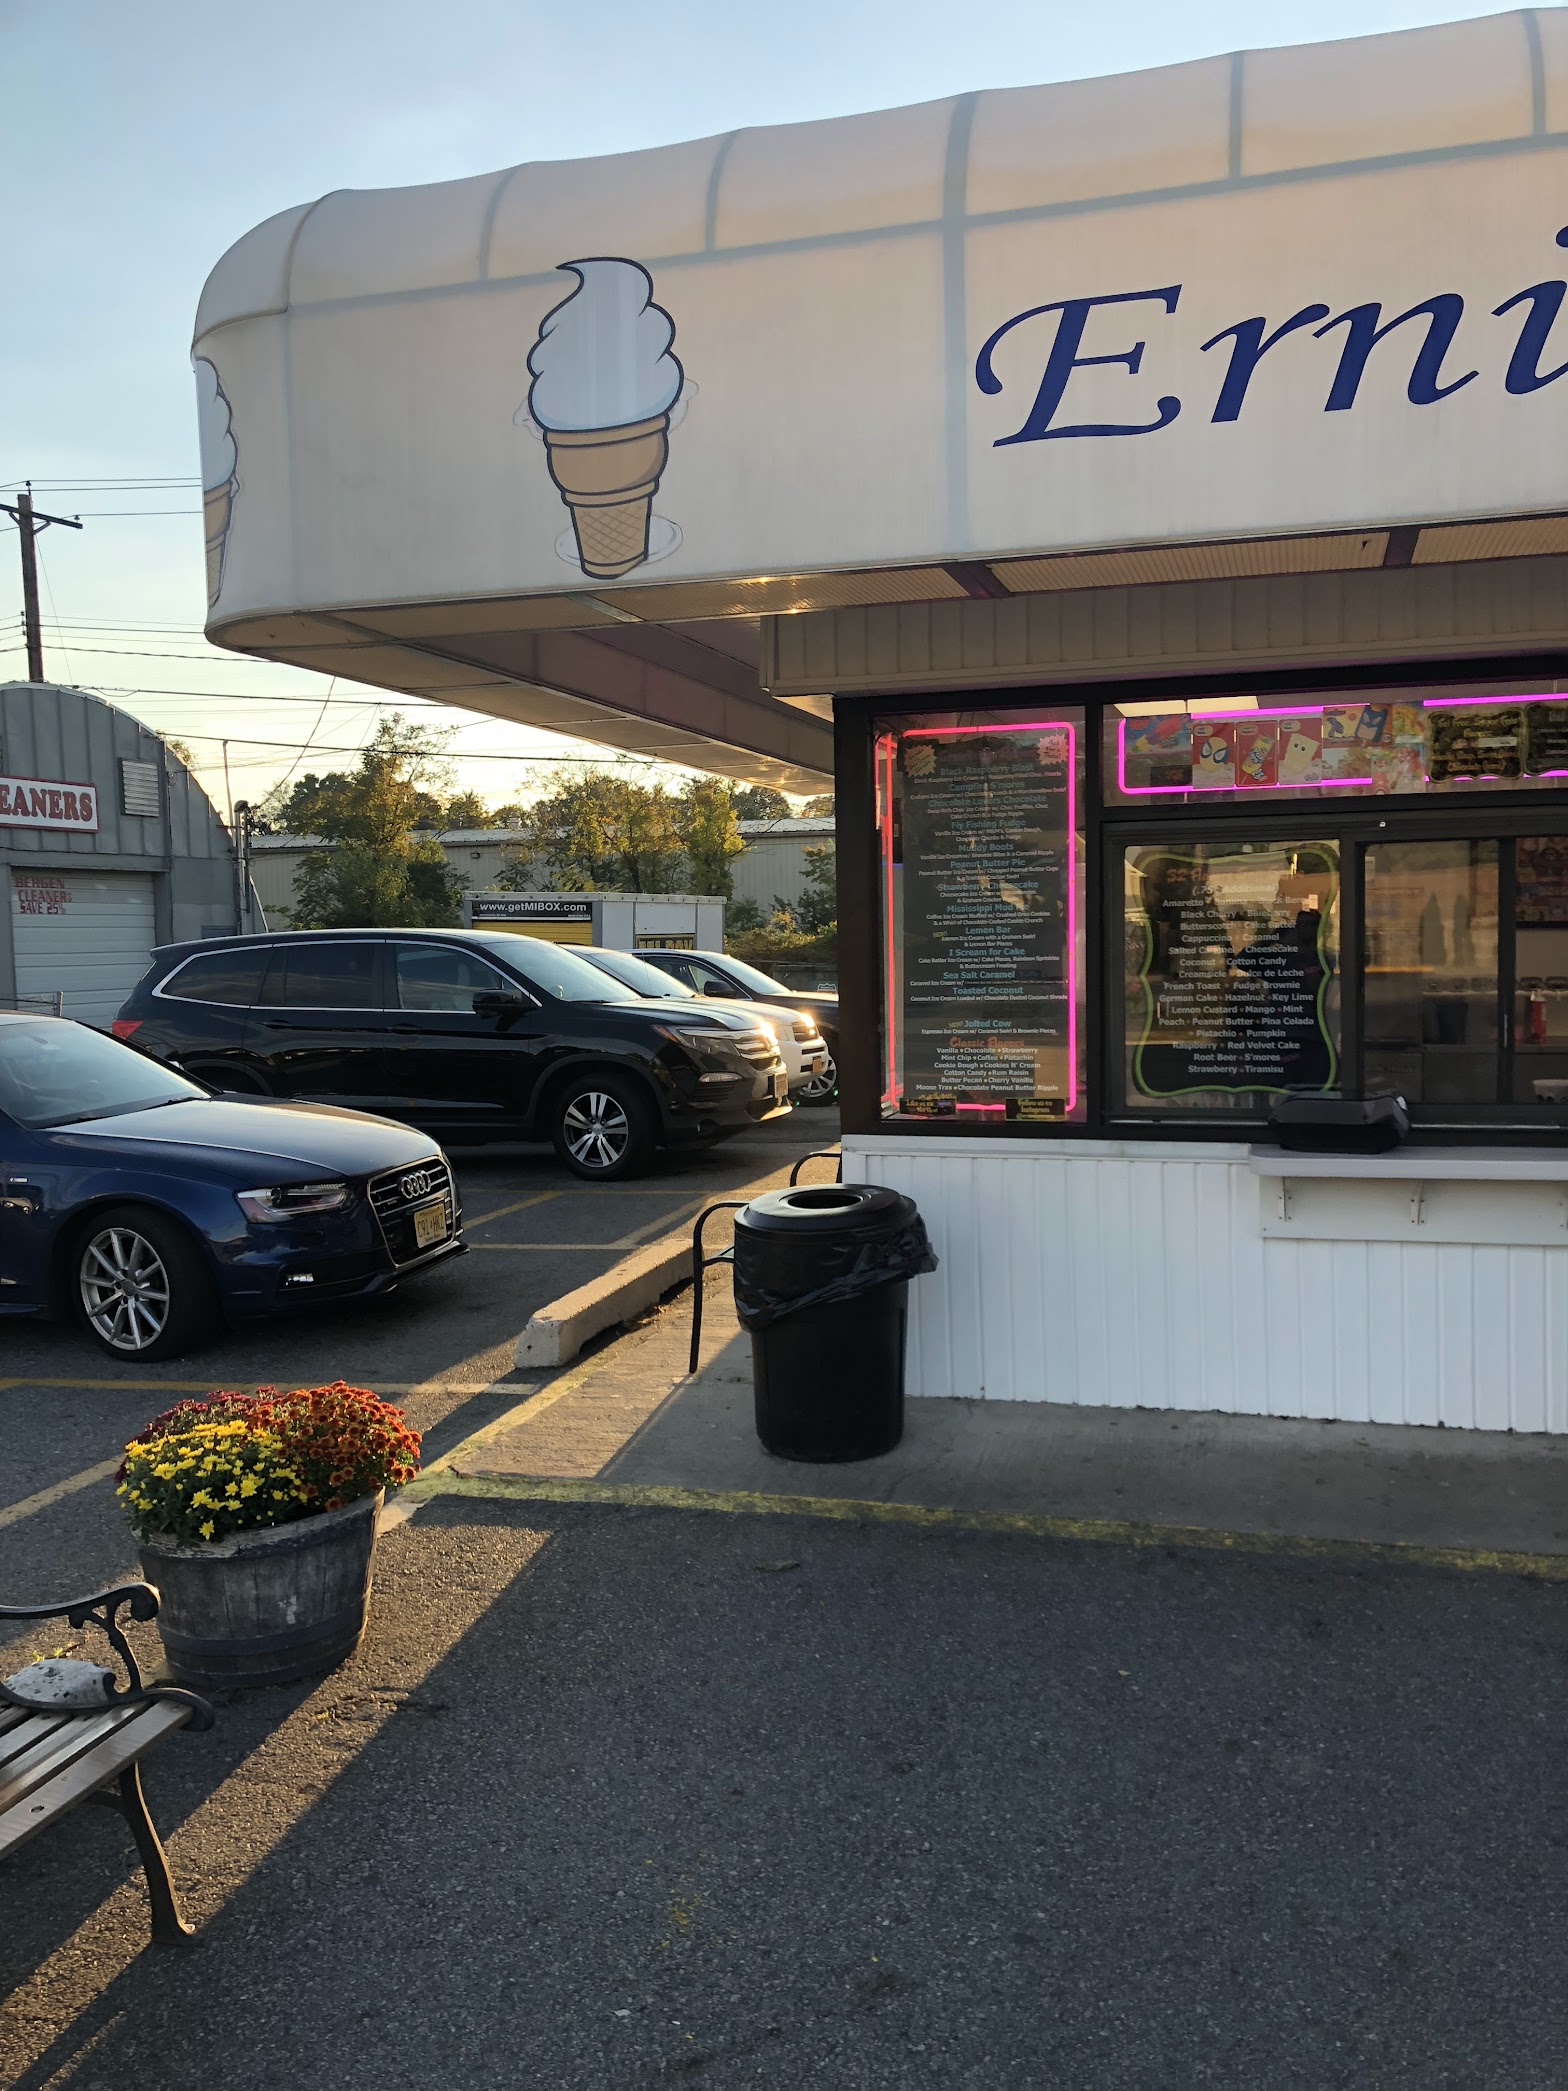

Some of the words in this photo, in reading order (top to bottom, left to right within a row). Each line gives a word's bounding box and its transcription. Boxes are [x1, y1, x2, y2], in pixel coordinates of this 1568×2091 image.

[975, 225, 1568, 447] Erni
[966, 765, 1009, 775] Raspberry
[949, 783, 987, 791] Campfir
[990, 781, 1025, 789] S'mores
[0, 784, 93, 822] EANERS
[929, 798, 970, 807] Chocolate
[1004, 794, 1046, 804] Chocolate
[951, 821, 965, 829] Fly
[966, 820, 997, 828] Fishing
[999, 819, 1025, 828] Fudge
[959, 844, 987, 852] Muddy
[983, 859, 1009, 867] Butter
[16, 877, 65, 888] BERGEN
[18, 890, 73, 903] CLEANERS
[480, 902, 587, 912] www.getMIBOX.com
[1163, 899, 1203, 907] Amaretto
[20, 902, 43, 914] SAVE
[947, 905, 992, 913] Mississippi
[1207, 911, 1236, 919] Cherry
[1180, 922, 1236, 930] Butterscotch
[1269, 921, 1296, 929] Batter
[1181, 935, 1233, 944] Cappuccino
[1242, 933, 1280, 941] Caramel
[955, 948, 986, 956] Scream
[1004, 947, 1025, 955] Cake
[1168, 947, 1196, 955] Salted
[1245, 945, 1298, 953] Cheesecake
[1227, 958, 1256, 966] Cotton
[1259, 957, 1286, 966] Candy
[1179, 970, 1226, 978] Creamsicle
[1264, 969, 1275, 977] de
[1278, 969, 1304, 977] Leche
[1164, 982, 1194, 990] French
[1233, 982, 1260, 990] Fudge
[953, 987, 986, 995] Toasted
[1159, 994, 1194, 1002] German
[1225, 993, 1265, 1001] Hazelnut
[1273, 993, 1289, 1002] Key
[1292, 993, 1313, 1001] Lime
[1172, 1006, 1201, 1014] Lemon
[1245, 1006, 1275, 1015] Mango
[1284, 1017, 1314, 1025] Colada
[1246, 1030, 1286, 1038] Pumpkin
[1172, 1042, 1217, 1051] Raspberry
[1228, 1041, 1245, 1049] Red
[1247, 1041, 1275, 1049] Velvet
[1278, 1041, 1300, 1049] Cake
[1194, 1053, 1215, 1061] Root
[1217, 1053, 1237, 1061] Beer
[1245, 1053, 1281, 1061] S'mores
[1188, 1065, 1237, 1074] Strawberry
[1245, 1065, 1283, 1073] Tiramisu
